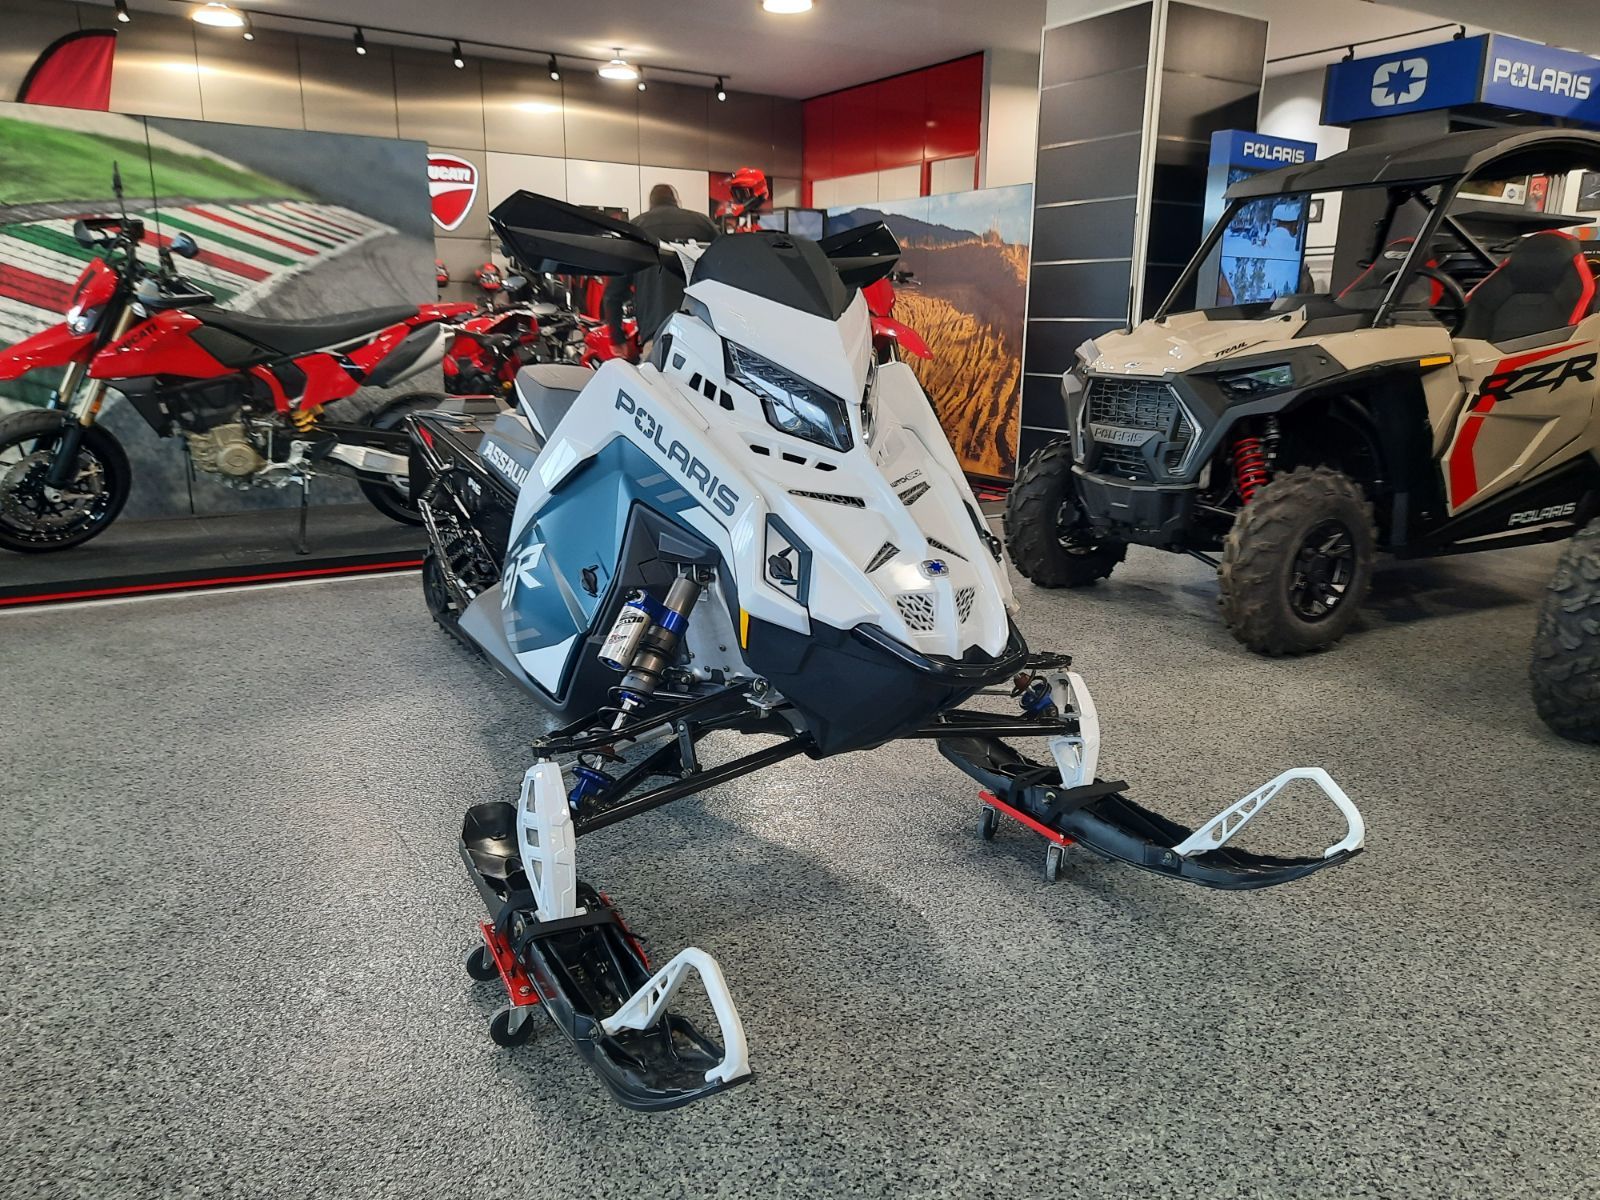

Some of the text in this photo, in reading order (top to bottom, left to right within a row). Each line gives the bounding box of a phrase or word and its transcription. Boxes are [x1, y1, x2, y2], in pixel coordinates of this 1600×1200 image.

[1493, 58, 1591, 100] POLARIS
[1243, 141, 1304, 163] POLARIS
[428, 165, 471, 182] UCATI
[1214, 341, 1248, 358] TRAIL
[1465, 352, 1598, 413] RZR
[1094, 427, 1145, 442] POLARIS
[482, 440, 529, 488] ASSAUL
[614, 387, 740, 517] POLARIS
[1507, 501, 1577, 526] POLARIS
